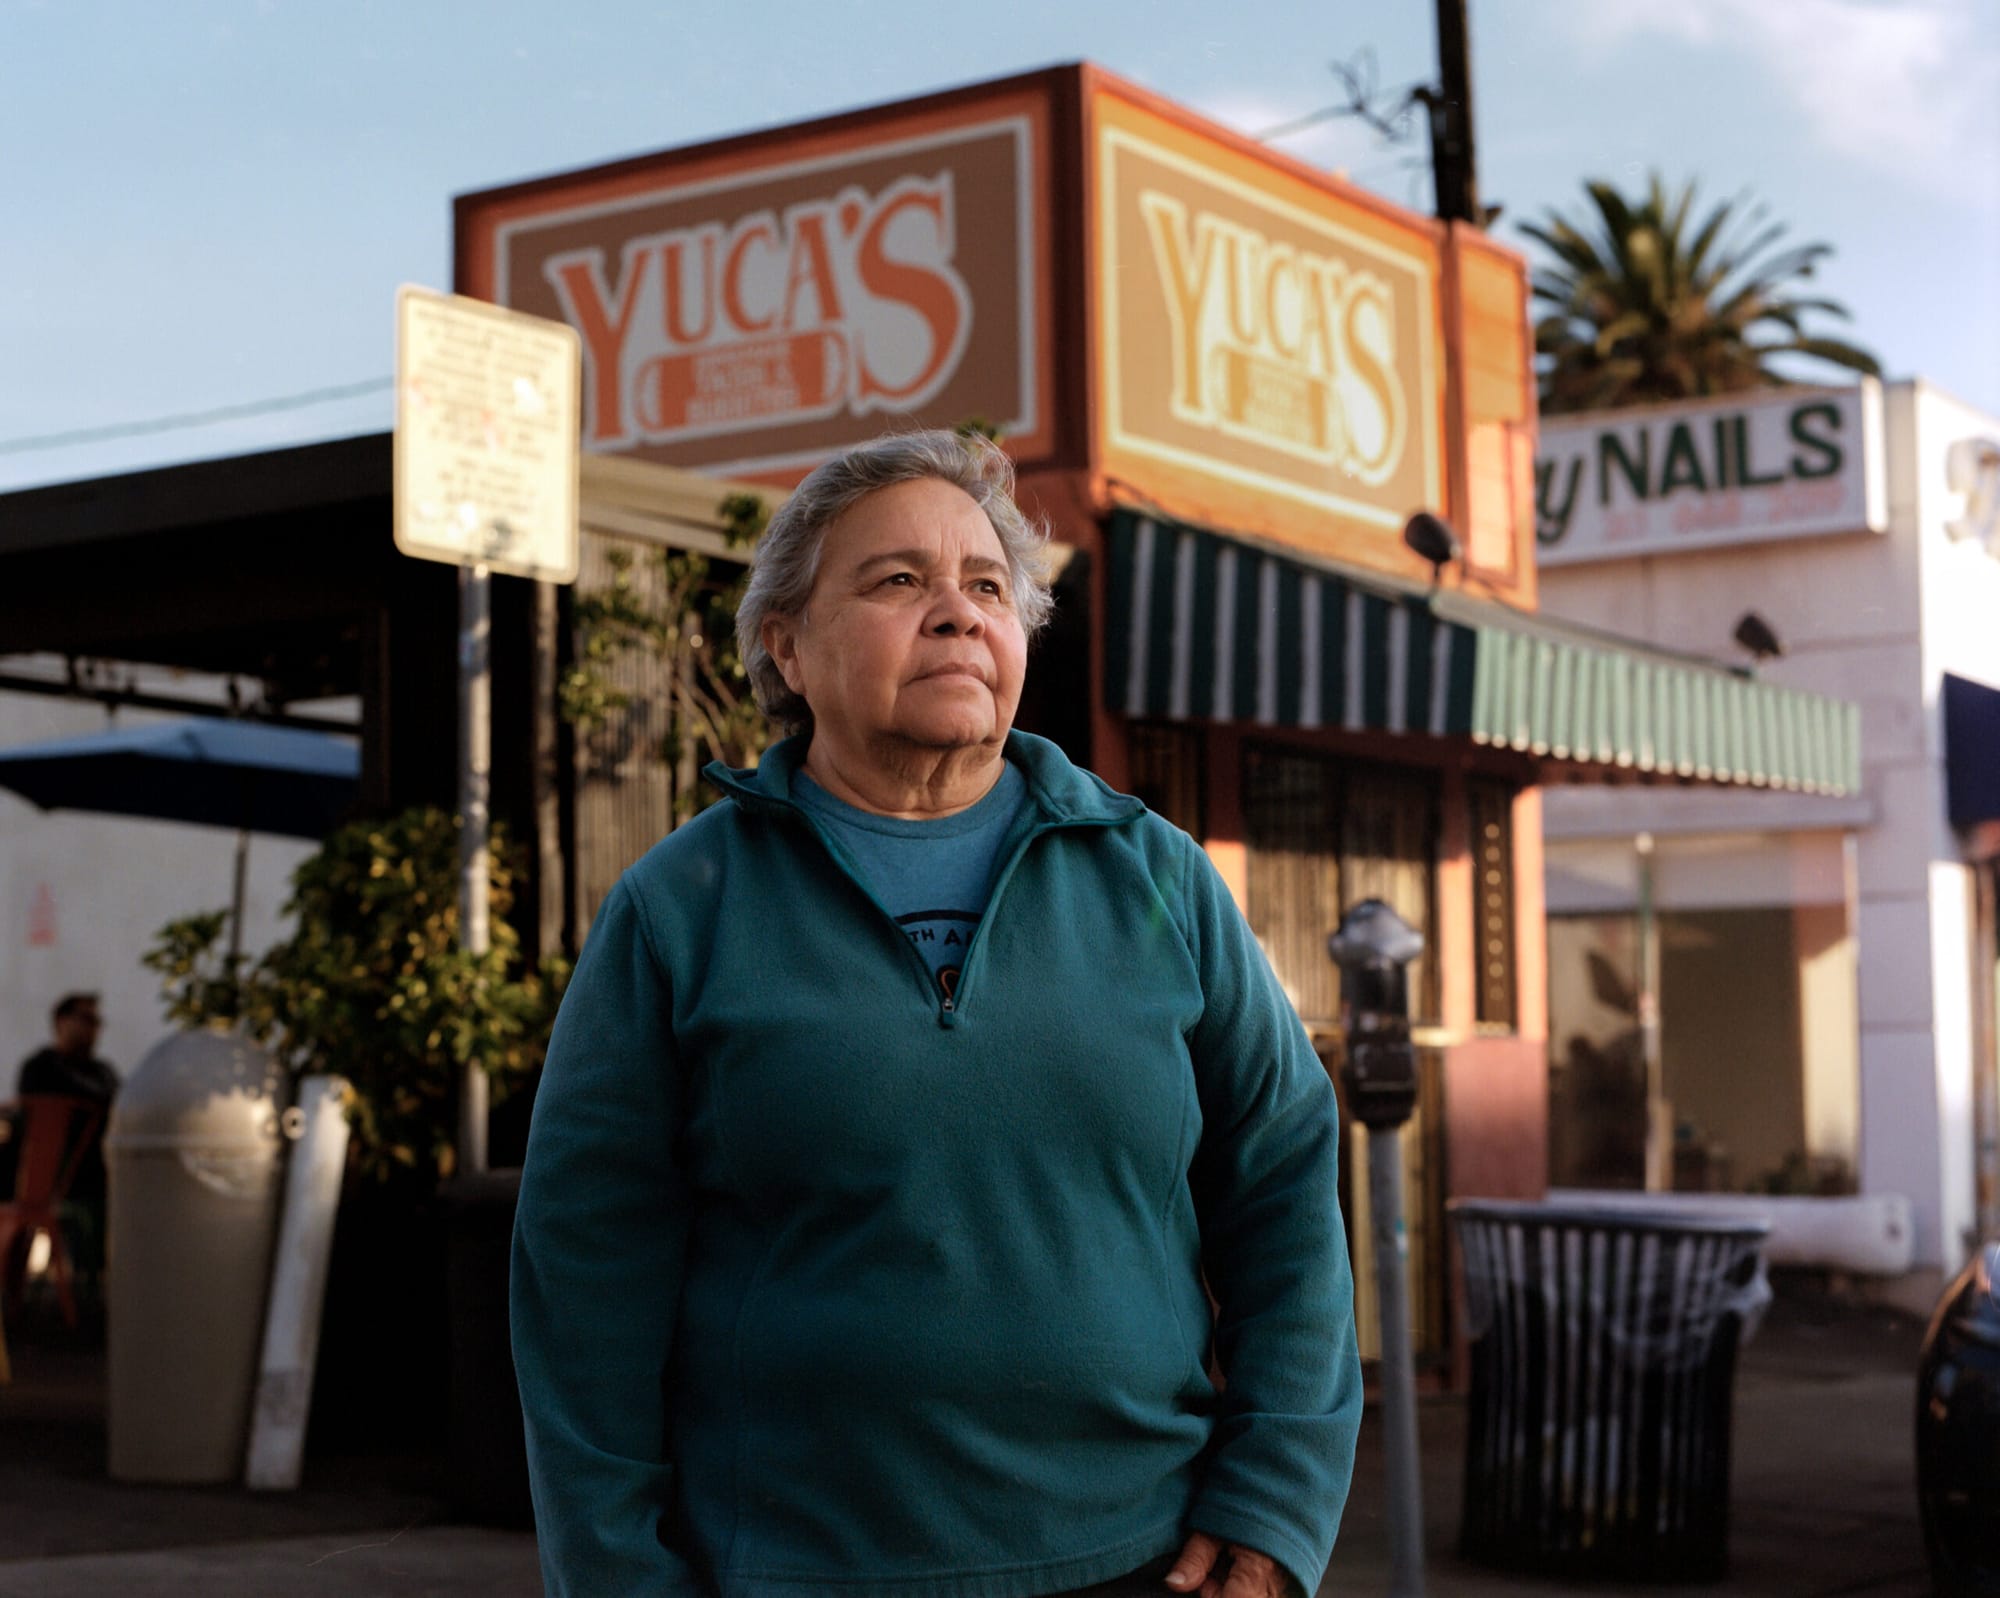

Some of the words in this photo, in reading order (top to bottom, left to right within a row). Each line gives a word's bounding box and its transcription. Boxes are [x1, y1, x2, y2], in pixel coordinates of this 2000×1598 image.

[549, 176, 968, 446] YUCA'S
[1143, 194, 1403, 480] YUCA'S
[1597, 403, 1844, 506] NAILS
